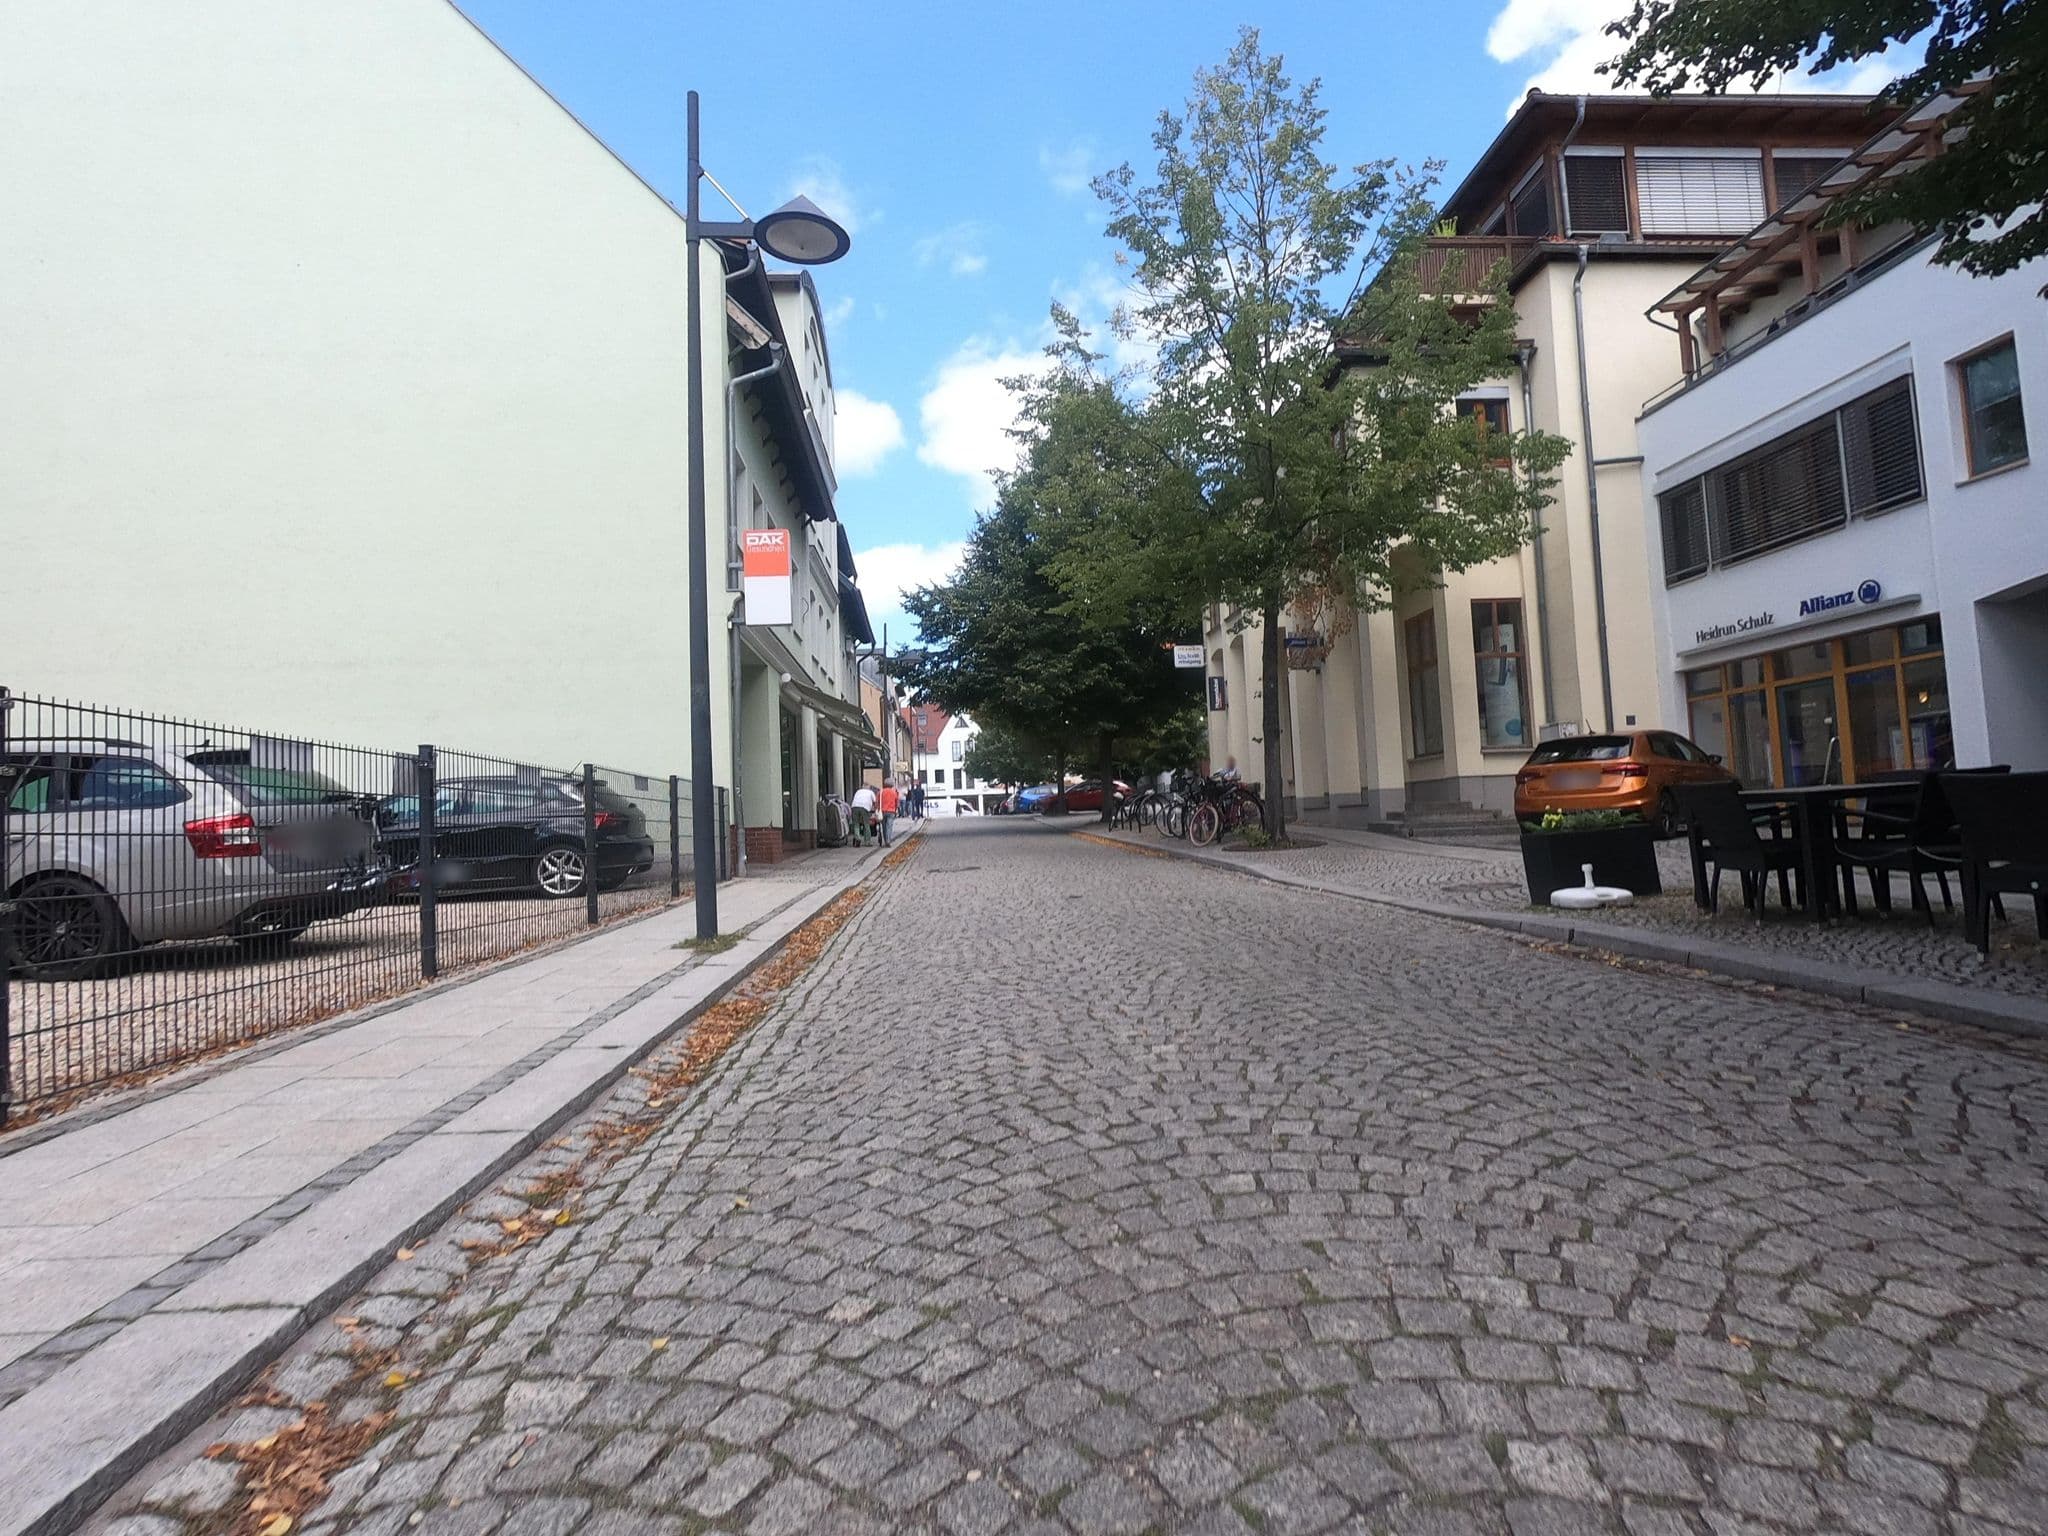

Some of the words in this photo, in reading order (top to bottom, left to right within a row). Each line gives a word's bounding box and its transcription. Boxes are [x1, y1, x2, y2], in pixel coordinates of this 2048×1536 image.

[746, 532, 784, 545] DAK
[1799, 590, 1855, 616] Allianz
[1696, 624, 1737, 644] Heidrun
[1737, 611, 1775, 632] Schulz
